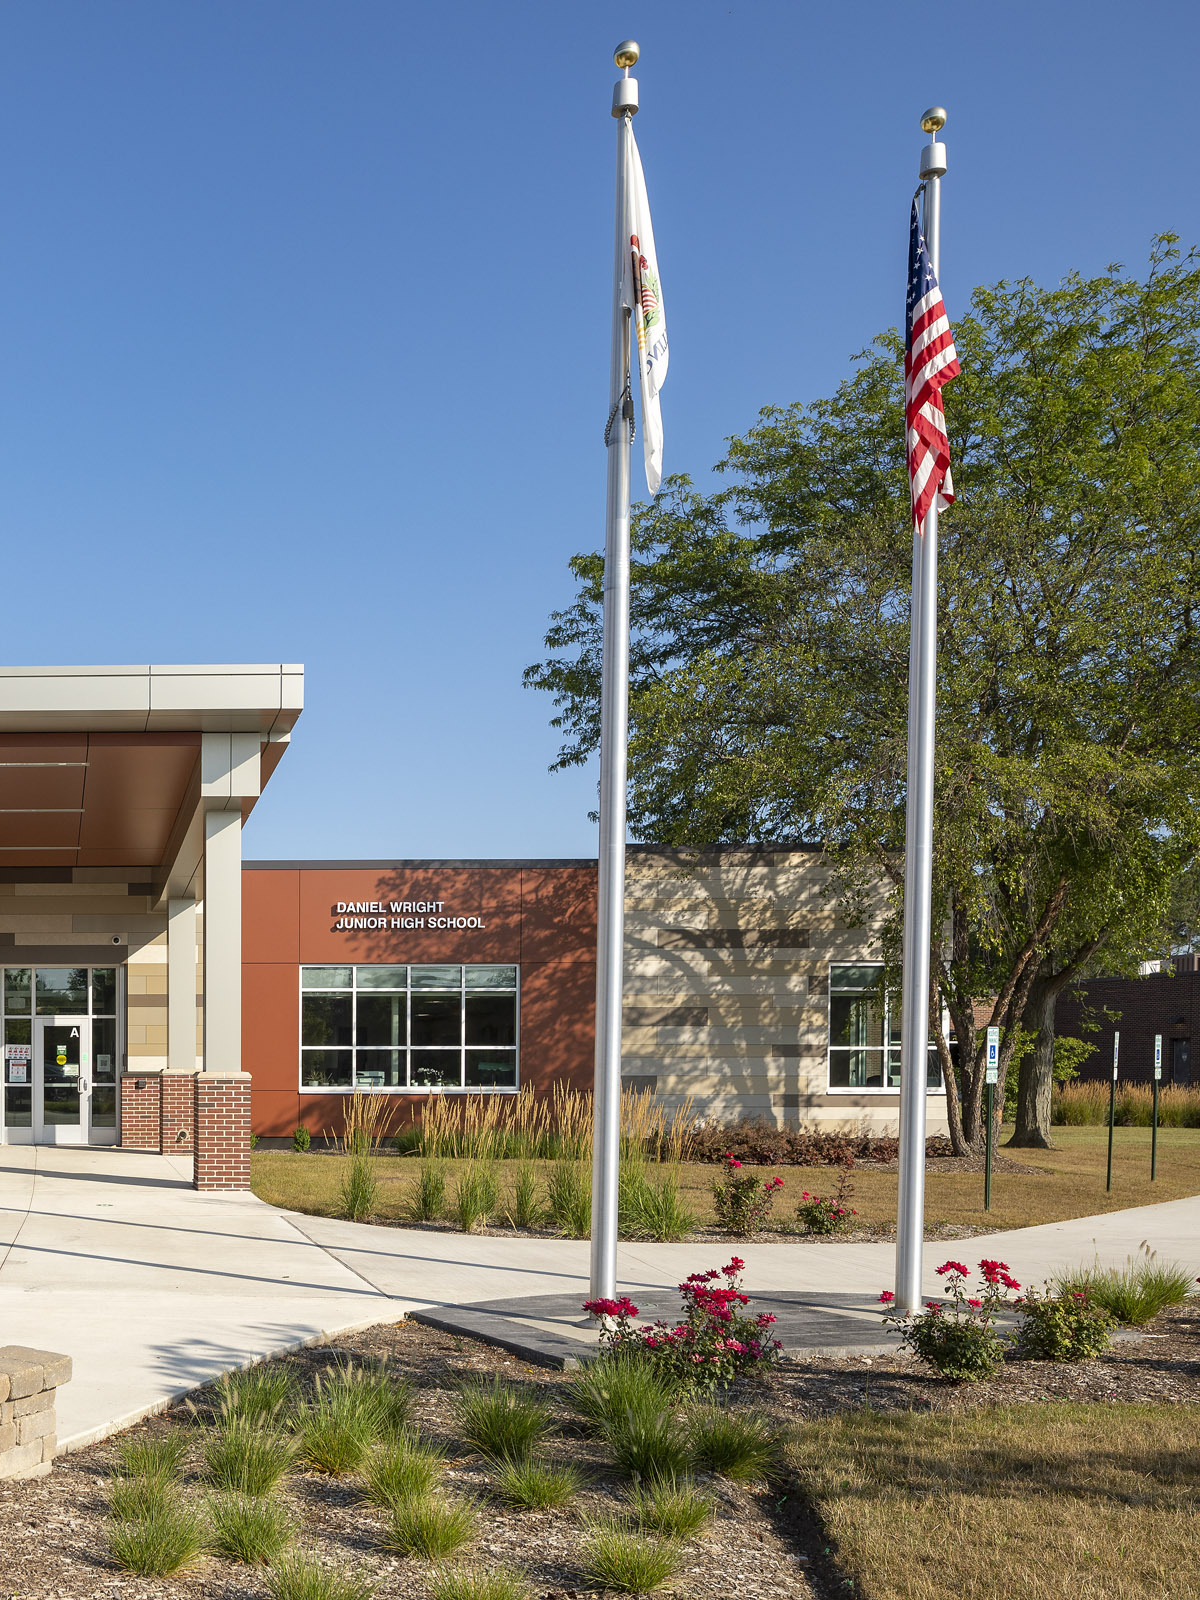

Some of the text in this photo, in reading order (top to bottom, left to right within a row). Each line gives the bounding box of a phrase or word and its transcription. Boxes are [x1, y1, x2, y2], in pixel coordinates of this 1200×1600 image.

[336, 901, 445, 913] DANIEL WRIGHT
[336, 917, 486, 929] JUNIOR HIGH SCHOOL
[69, 1027, 80, 1038] A
